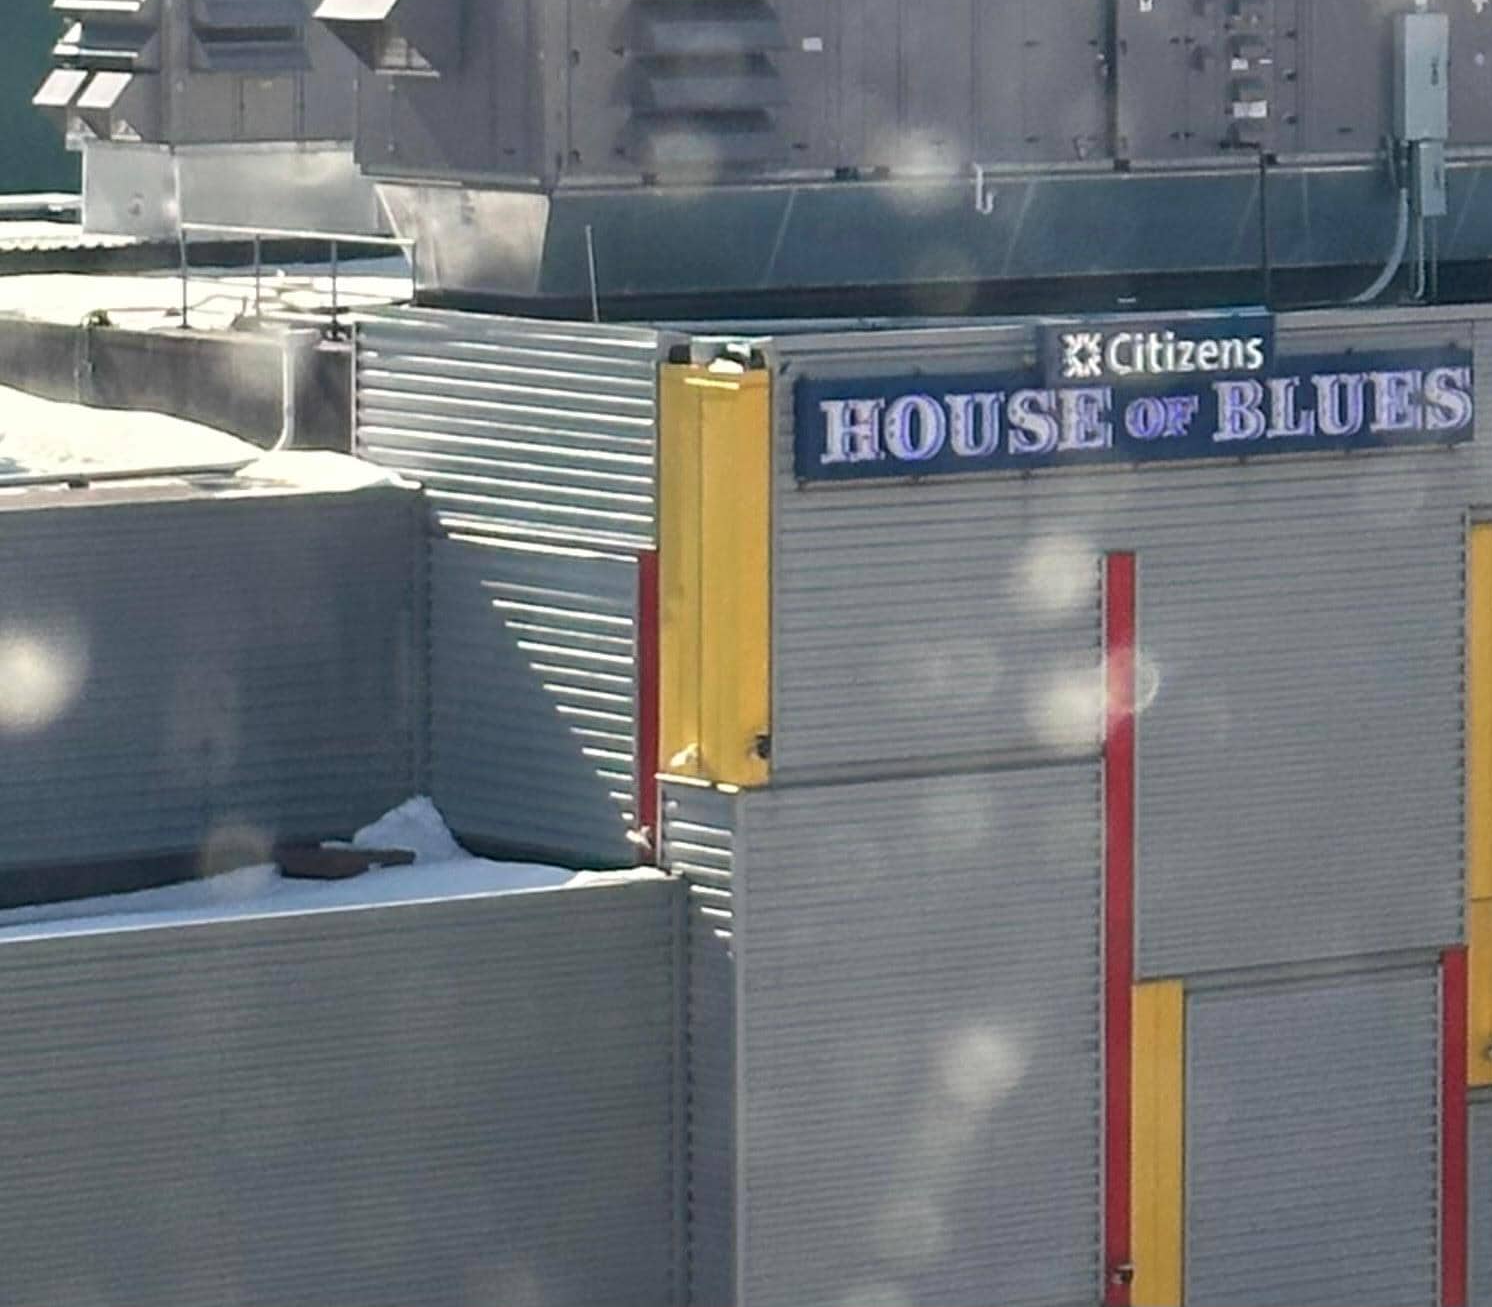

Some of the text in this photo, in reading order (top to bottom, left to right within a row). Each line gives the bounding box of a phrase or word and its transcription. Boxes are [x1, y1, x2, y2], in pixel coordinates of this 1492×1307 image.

[1109, 330, 1265, 375] Citizens
[819, 366, 1474, 465] HOUSE OF BLUES
